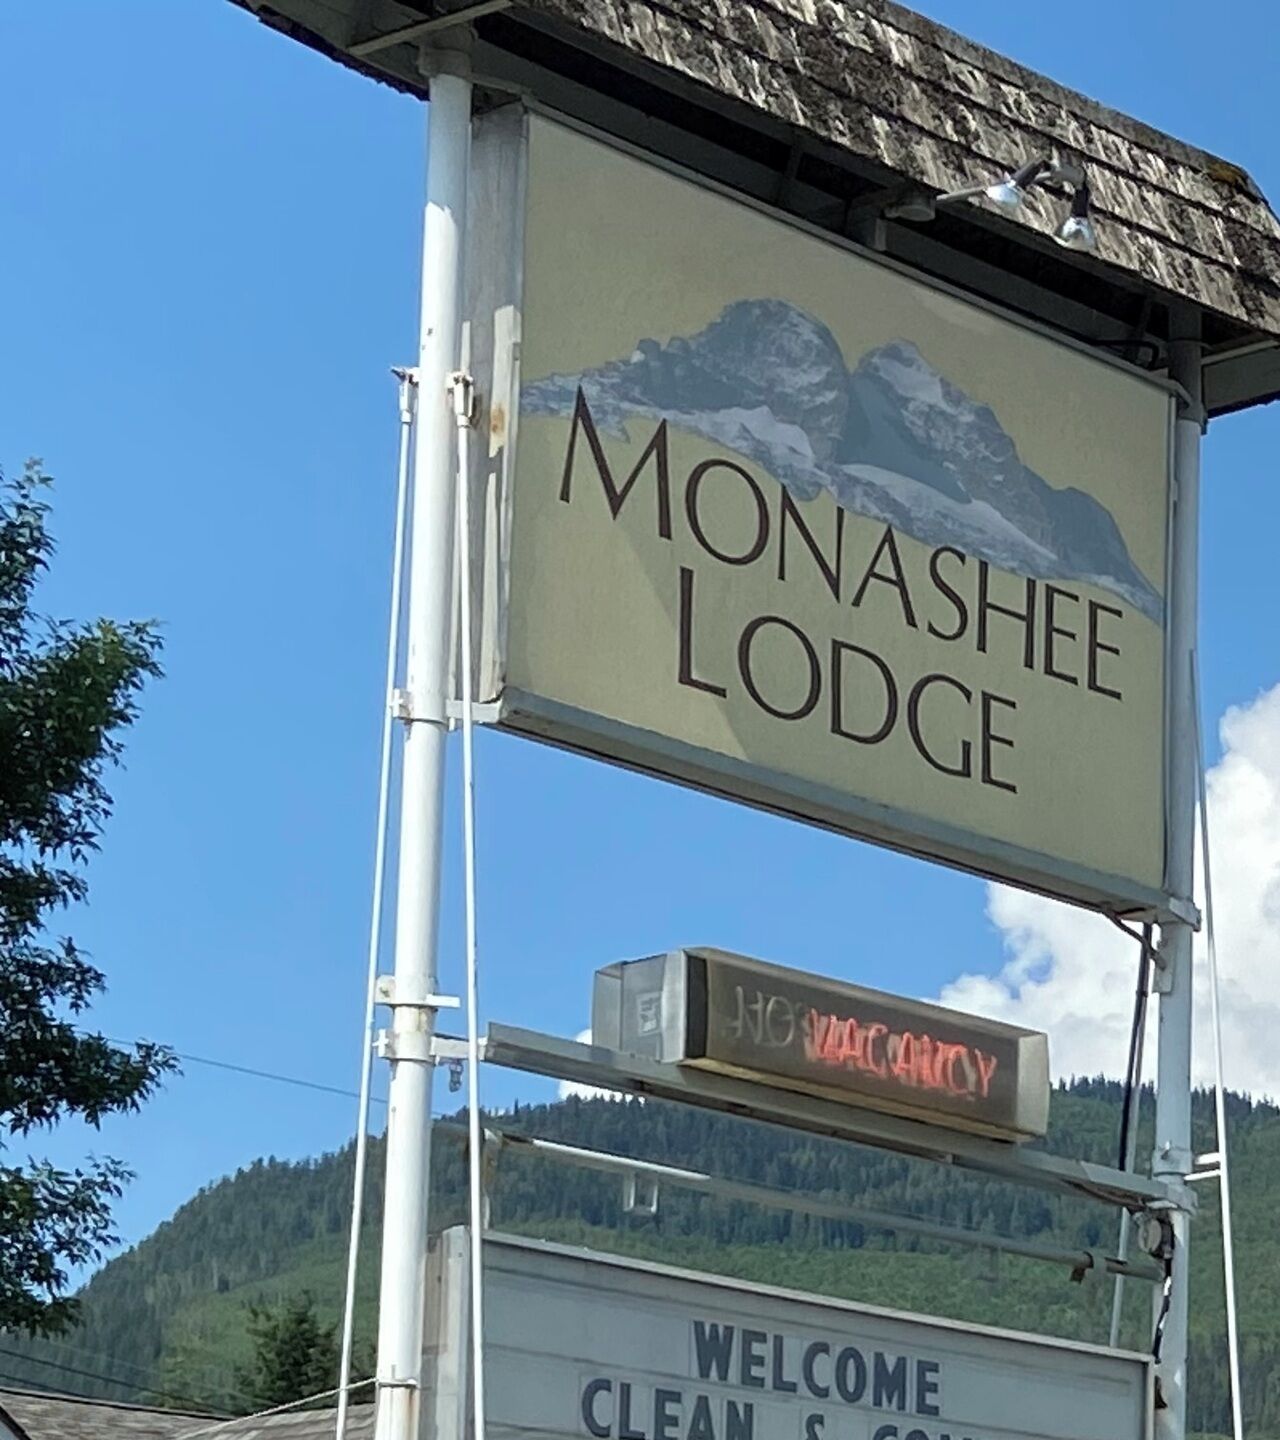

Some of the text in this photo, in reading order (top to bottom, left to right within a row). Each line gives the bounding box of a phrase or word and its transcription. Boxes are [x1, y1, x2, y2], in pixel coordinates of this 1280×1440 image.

[560, 385, 1123, 700] MONASHEE
[677, 566, 1018, 794] LODGE
[728, 985, 796, 1047] NO
[806, 1007, 998, 1099] VACANCY
[693, 1320, 940, 1416] WELCOME
